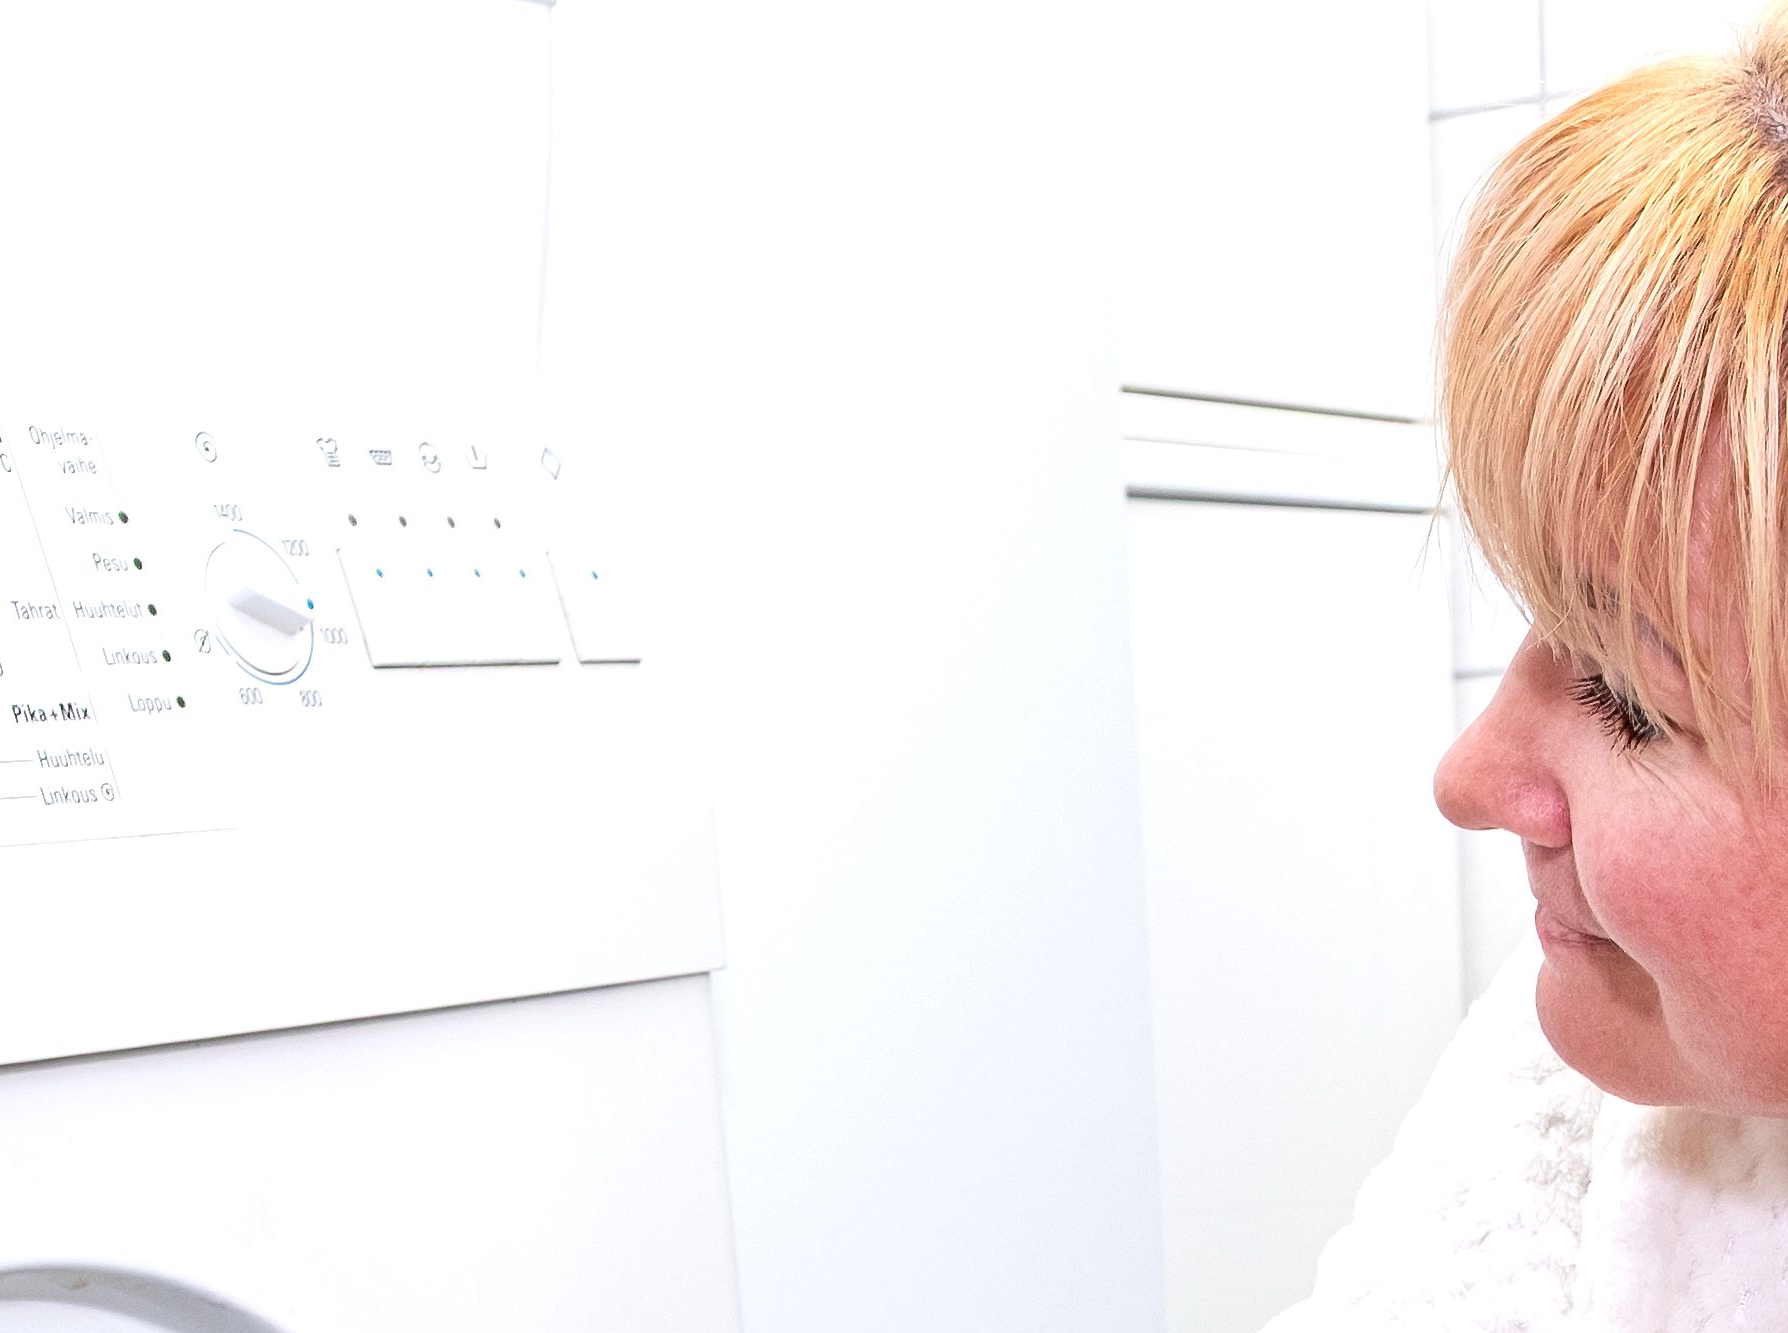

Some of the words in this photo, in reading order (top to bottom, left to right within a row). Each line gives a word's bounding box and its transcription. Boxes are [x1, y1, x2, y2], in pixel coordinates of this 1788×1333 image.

[28, 425, 93, 450] Ohjelma-
[59, 457, 98, 475] vaihe
[64, 506, 115, 526] Valmis
[92, 552, 129, 572] Pesu
[10, 600, 60, 620] Tahrat
[72, 599, 143, 619] Huuhtelut
[319, 627, 349, 645] 1000
[101, 647, 158, 666] Linkous
[11, 702, 91, 724] Pika+Mix
[127, 693, 173, 715] Loppu
[36, 747, 105, 769] Huuhtelu
[39, 786, 99, 806] Linkous
